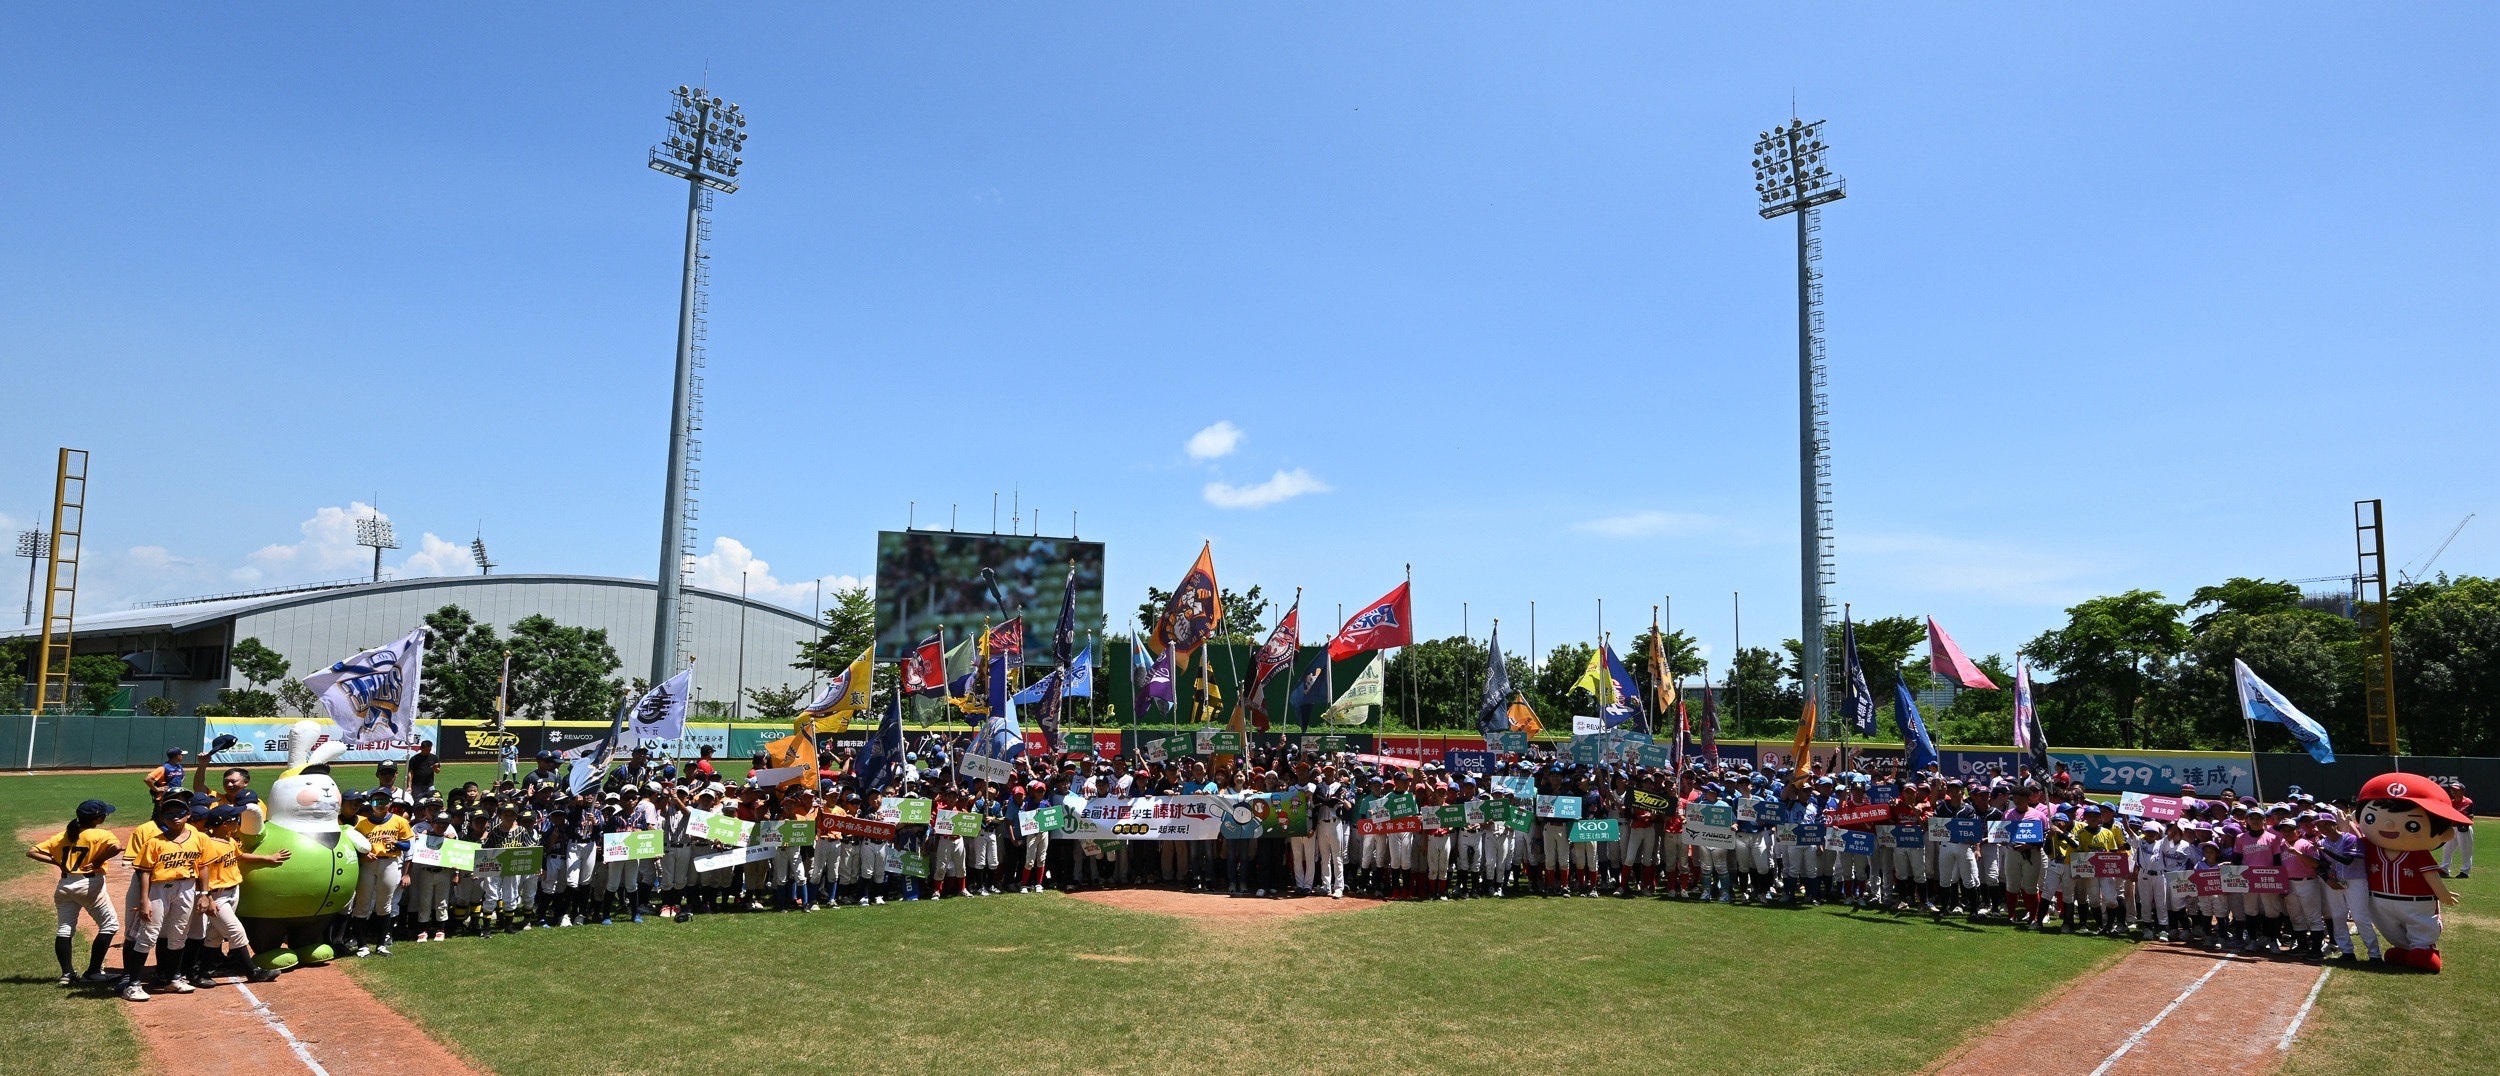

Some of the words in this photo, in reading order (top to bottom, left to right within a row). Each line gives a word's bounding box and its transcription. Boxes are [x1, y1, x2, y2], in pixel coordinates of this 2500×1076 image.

[1454, 753, 1485, 768] best
[2100, 766, 2153, 786] 299
[62, 846, 90, 877] 17
[164, 859, 195, 870] GIRLS
